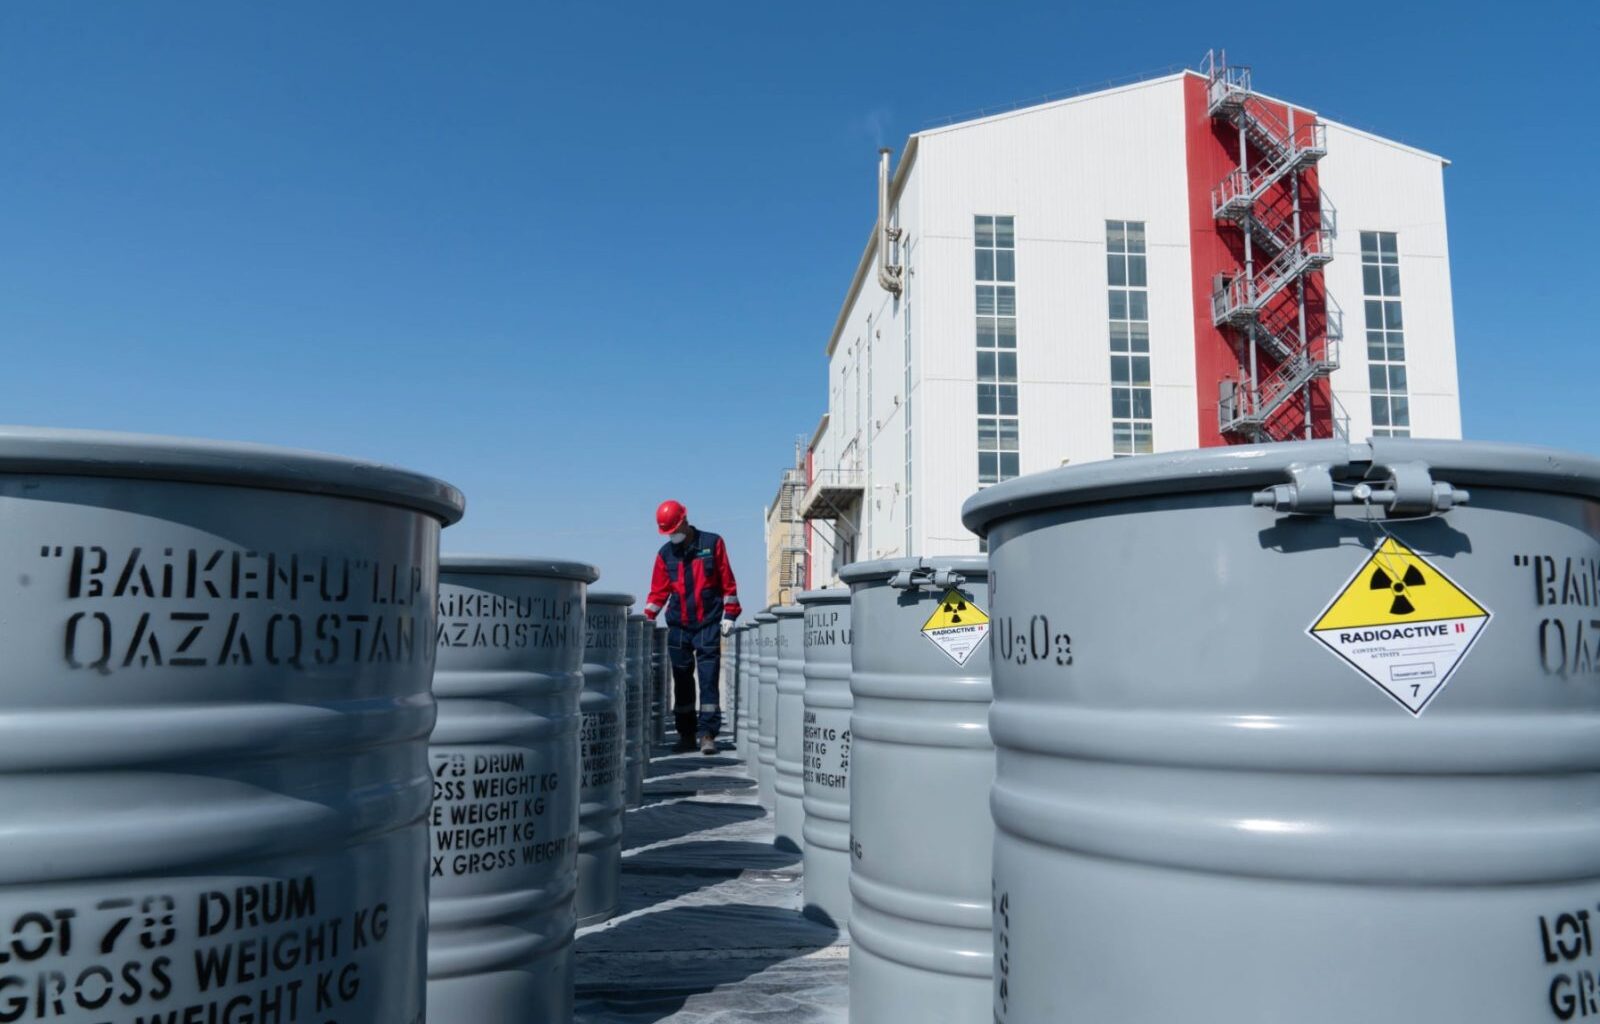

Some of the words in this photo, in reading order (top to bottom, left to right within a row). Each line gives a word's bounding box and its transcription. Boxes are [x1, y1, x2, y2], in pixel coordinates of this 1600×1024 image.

[64, 611, 415, 675] QAZAQSTAN
[932, 626, 976, 636] RADIOACTIVE
[1340, 624, 1449, 644] RADIOACTIVE
[1410, 684, 1421, 698] 7
[823, 728, 836, 741] KG
[815, 743, 827, 755] KG
[474, 753, 524, 775] DRUM
[473, 776, 537, 799] WEIGHT
[541, 772, 558, 792] KG
[816, 772, 847, 789] WEIGHT
[451, 801, 519, 825] WEIGHT
[524, 798, 545, 818] KG
[437, 826, 507, 850] WEIGHT
[513, 822, 535, 843] KG
[453, 848, 516, 875] GROSS
[198, 875, 315, 937] DRUM
[194, 916, 343, 993] WEIGHT
[353, 903, 389, 951] KG
[1539, 909, 1593, 963] LOT
[316, 963, 361, 1013] KG
